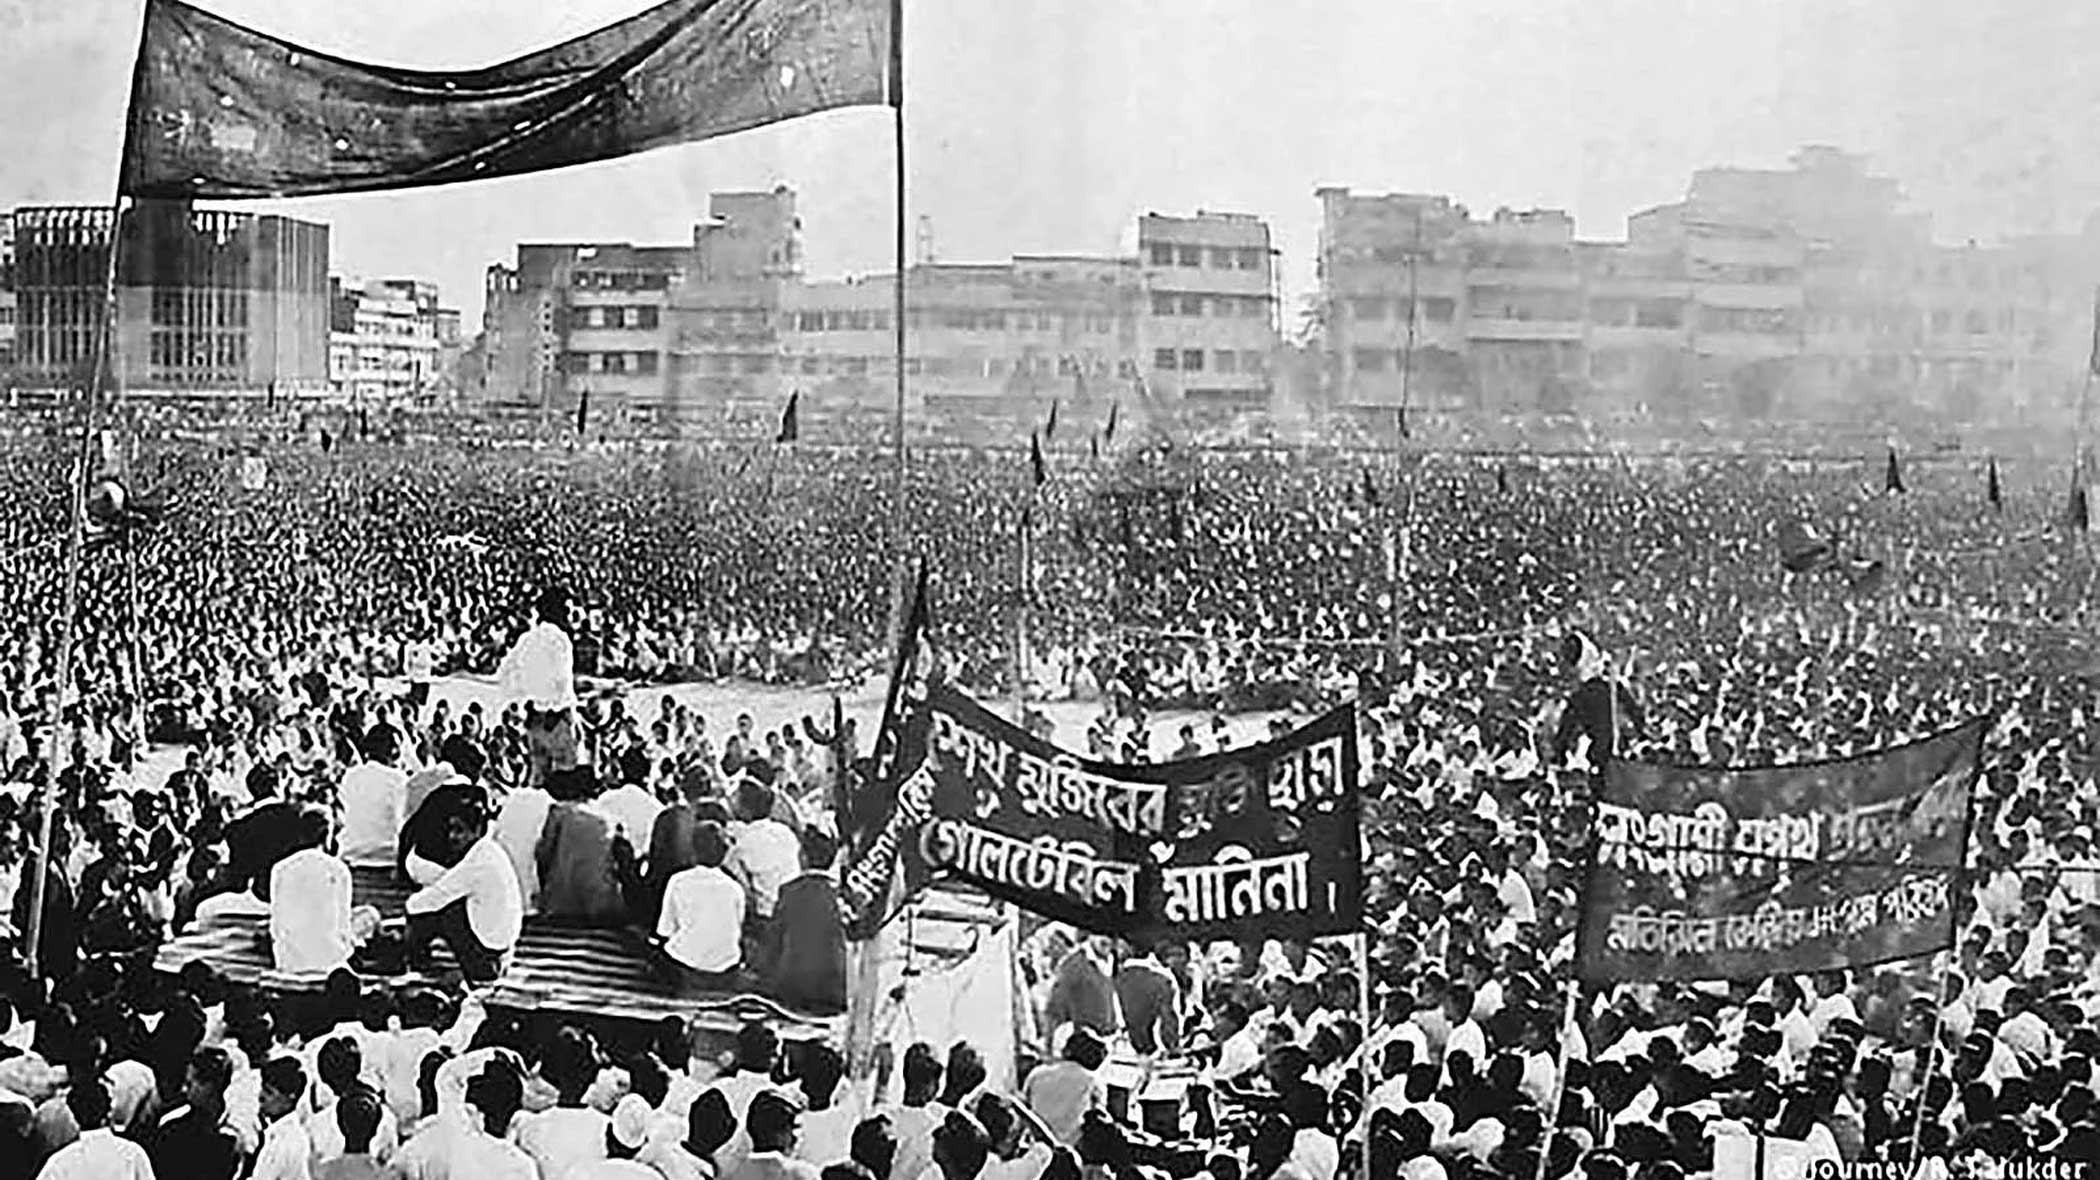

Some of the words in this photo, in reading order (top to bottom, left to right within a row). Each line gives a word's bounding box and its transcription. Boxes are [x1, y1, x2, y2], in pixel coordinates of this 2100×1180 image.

[1016, 752, 1168, 835] মুজিবের
[919, 816, 1141, 912] গোলটেবিল
[1161, 844, 1310, 923] মানিনা
